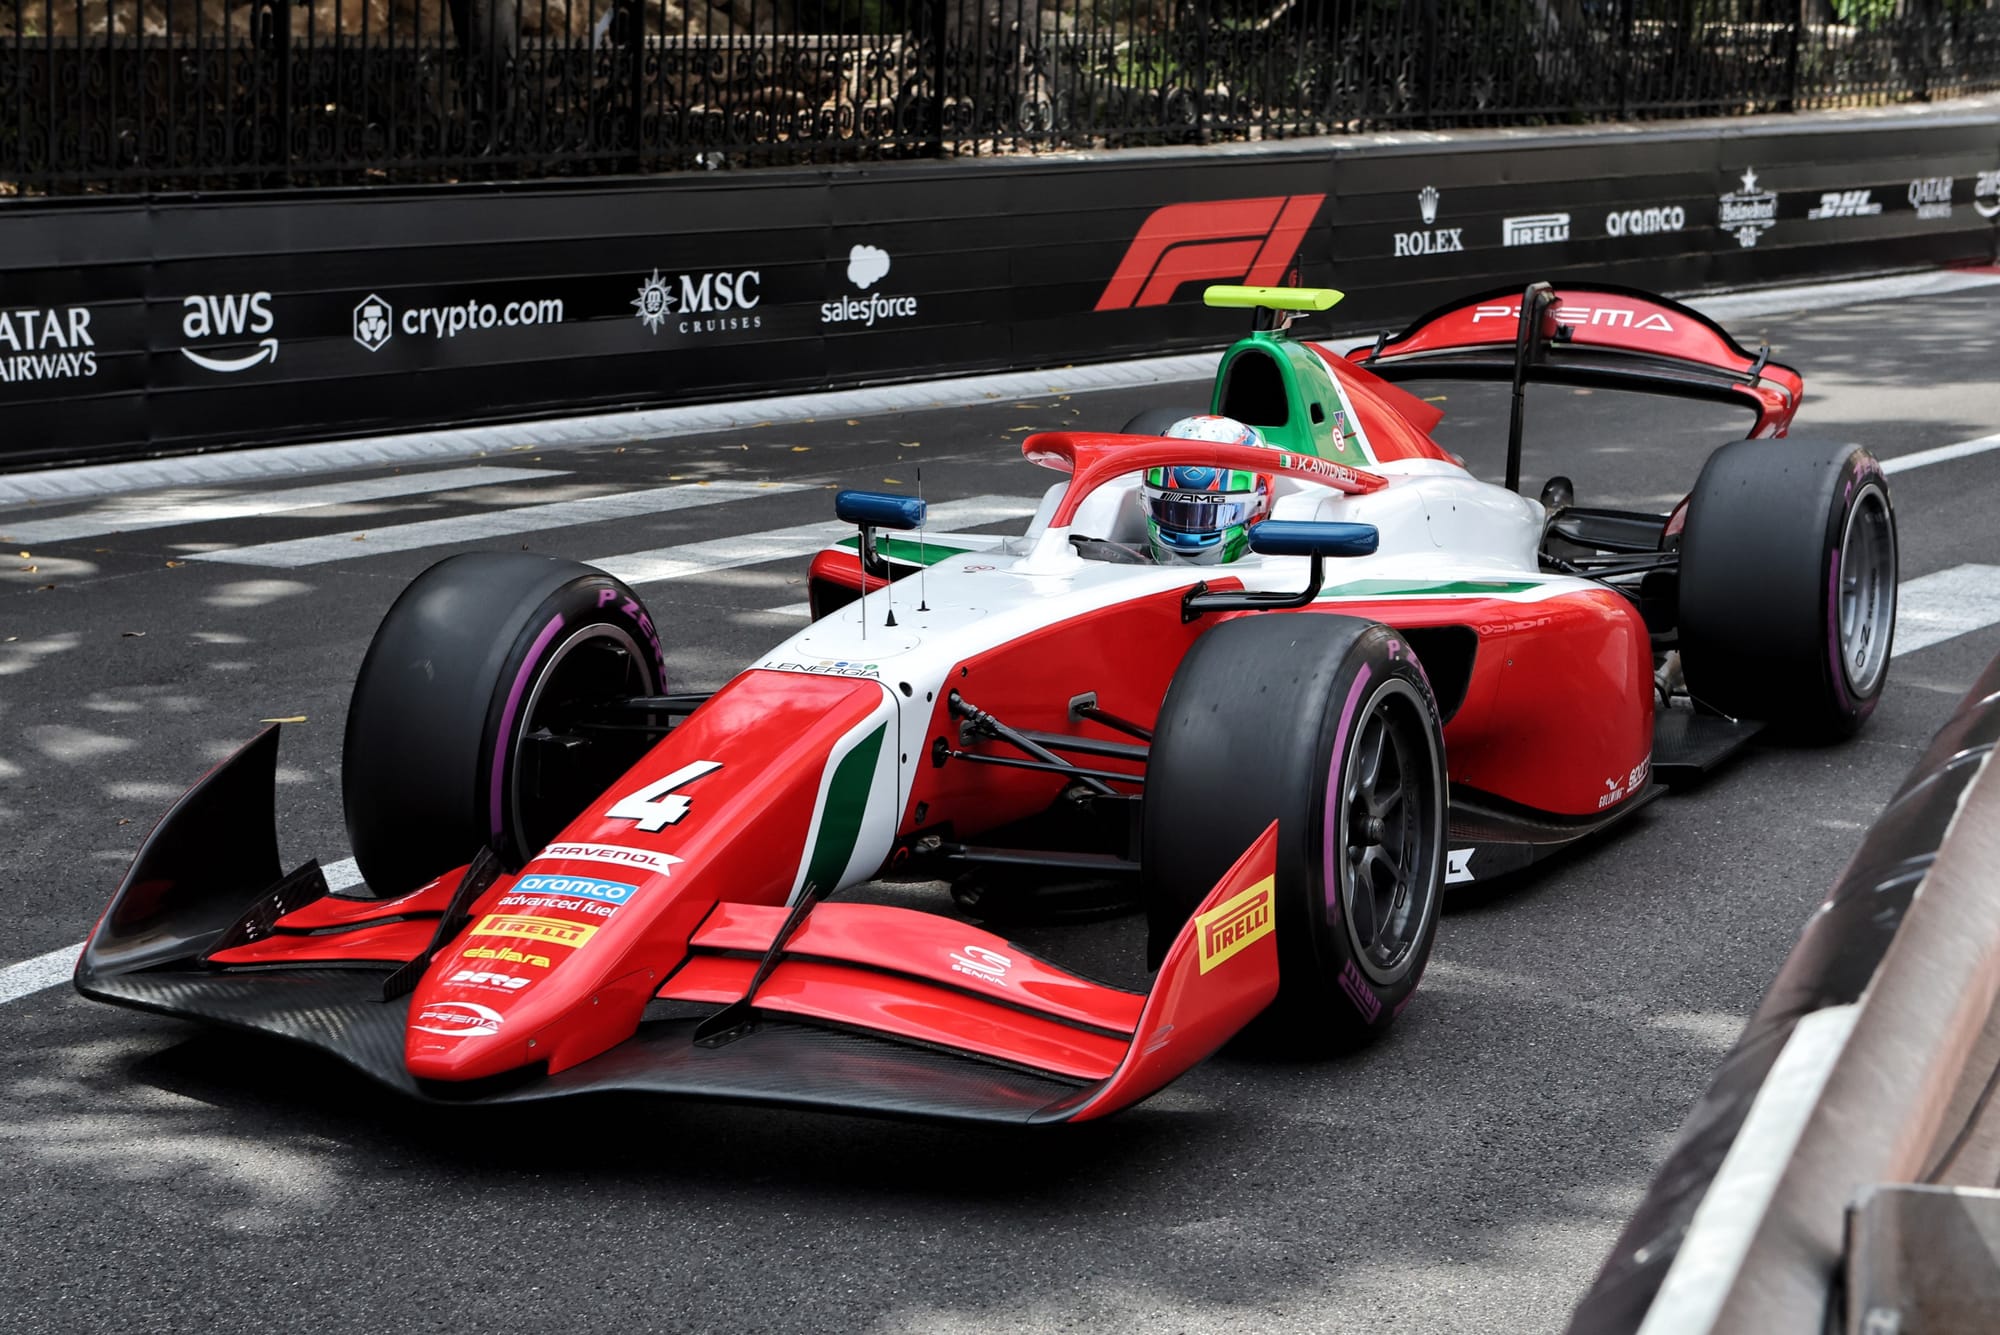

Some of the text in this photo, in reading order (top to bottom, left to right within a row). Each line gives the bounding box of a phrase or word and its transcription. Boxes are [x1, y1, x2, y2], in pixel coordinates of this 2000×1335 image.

[1819, 190, 1872, 218] DHL
[1908, 177, 1952, 208] QATAR
[1503, 213, 1570, 247] PIRELLI
[1606, 206, 1685, 237] aramco
[1394, 228, 1464, 257] ROLEX
[678, 271, 760, 314] MSC
[183, 291, 274, 338] aws
[402, 299, 563, 338] crypto.com
[821, 292, 917, 327] salesforce
[1473, 306, 1674, 332] PEMA
[0, 307, 95, 351] ATAR
[679, 316, 761, 333] CRUISES
[1179, 494, 1225, 503] AMG
[763, 661, 881, 679] LENERGIA
[604, 760, 724, 833] 4
[549, 845, 662, 868] RAVENOL
[520, 875, 627, 901] aramco
[498, 894, 619, 919] advanced fuel
[484, 916, 587, 942] PIRELLI
[1205, 889, 1269, 960] PIRELLI
[462, 944, 551, 969] dallara
